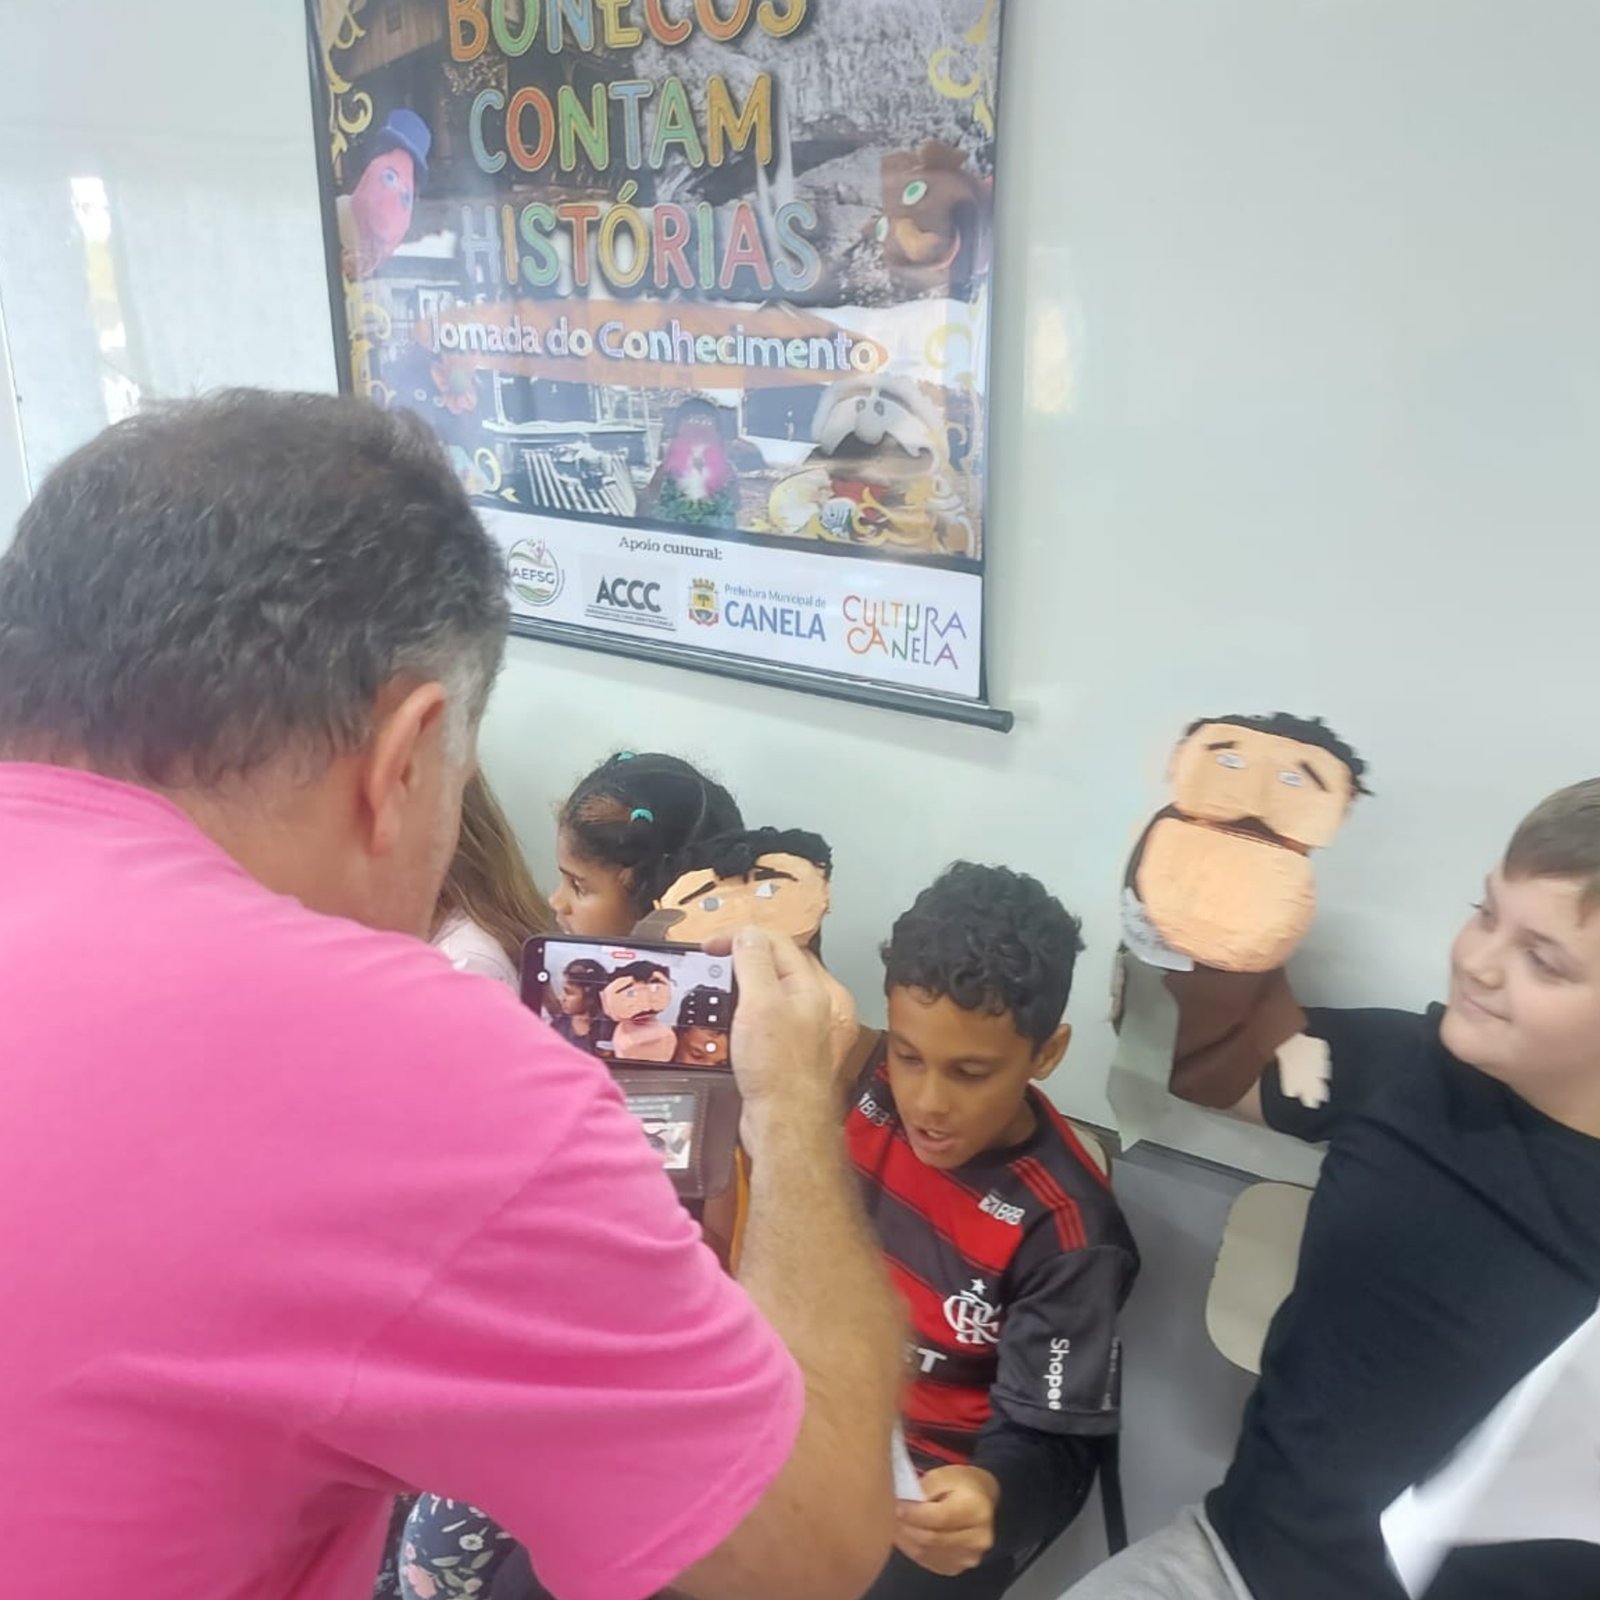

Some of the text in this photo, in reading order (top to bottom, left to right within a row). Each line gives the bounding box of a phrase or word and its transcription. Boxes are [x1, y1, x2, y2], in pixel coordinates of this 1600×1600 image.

[469, 73, 773, 173] CONTAM
[460, 181, 822, 292] HISTÓRIAS
[430, 309, 877, 373] Jornada do Conhecimento
[618, 536, 661, 553] Apoio
[595, 575, 662, 613] ACCC
[724, 584, 827, 609] Prefeitura Municipal de
[724, 600, 827, 642] CANELA
[842, 595, 968, 640] CULTURA
[847, 626, 959, 671] CANELA
